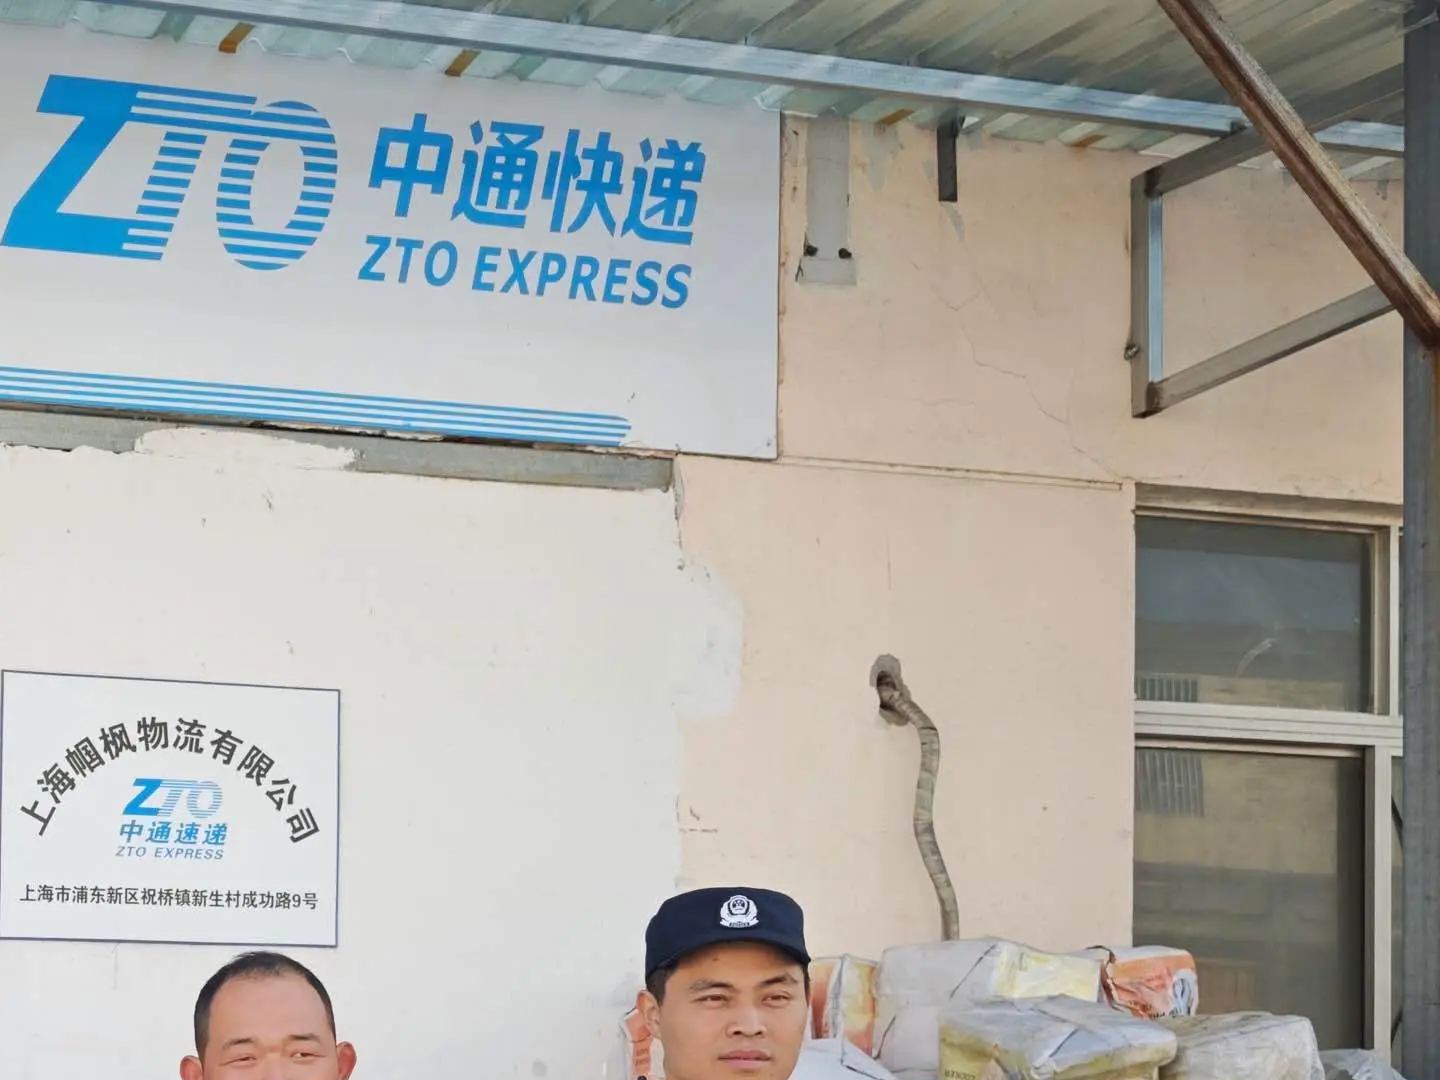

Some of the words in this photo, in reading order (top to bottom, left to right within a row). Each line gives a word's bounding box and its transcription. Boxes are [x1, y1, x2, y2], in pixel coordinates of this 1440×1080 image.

[0, 74, 339, 271] ZTO
[367, 112, 707, 246] 中通快递
[358, 234, 458, 288] ZTO
[471, 245, 693, 310] EXPRESS
[19, 716, 320, 844] 上海帼枫物流有限公司
[122, 778, 224, 819] ZTO
[115, 845, 147, 858] ZTO
[154, 846, 225, 861] EXPRESS
[119, 819, 228, 846] 中通速递
[19, 884, 320, 911] 上海市浦东新区祝桥镇新生村成功路9号
